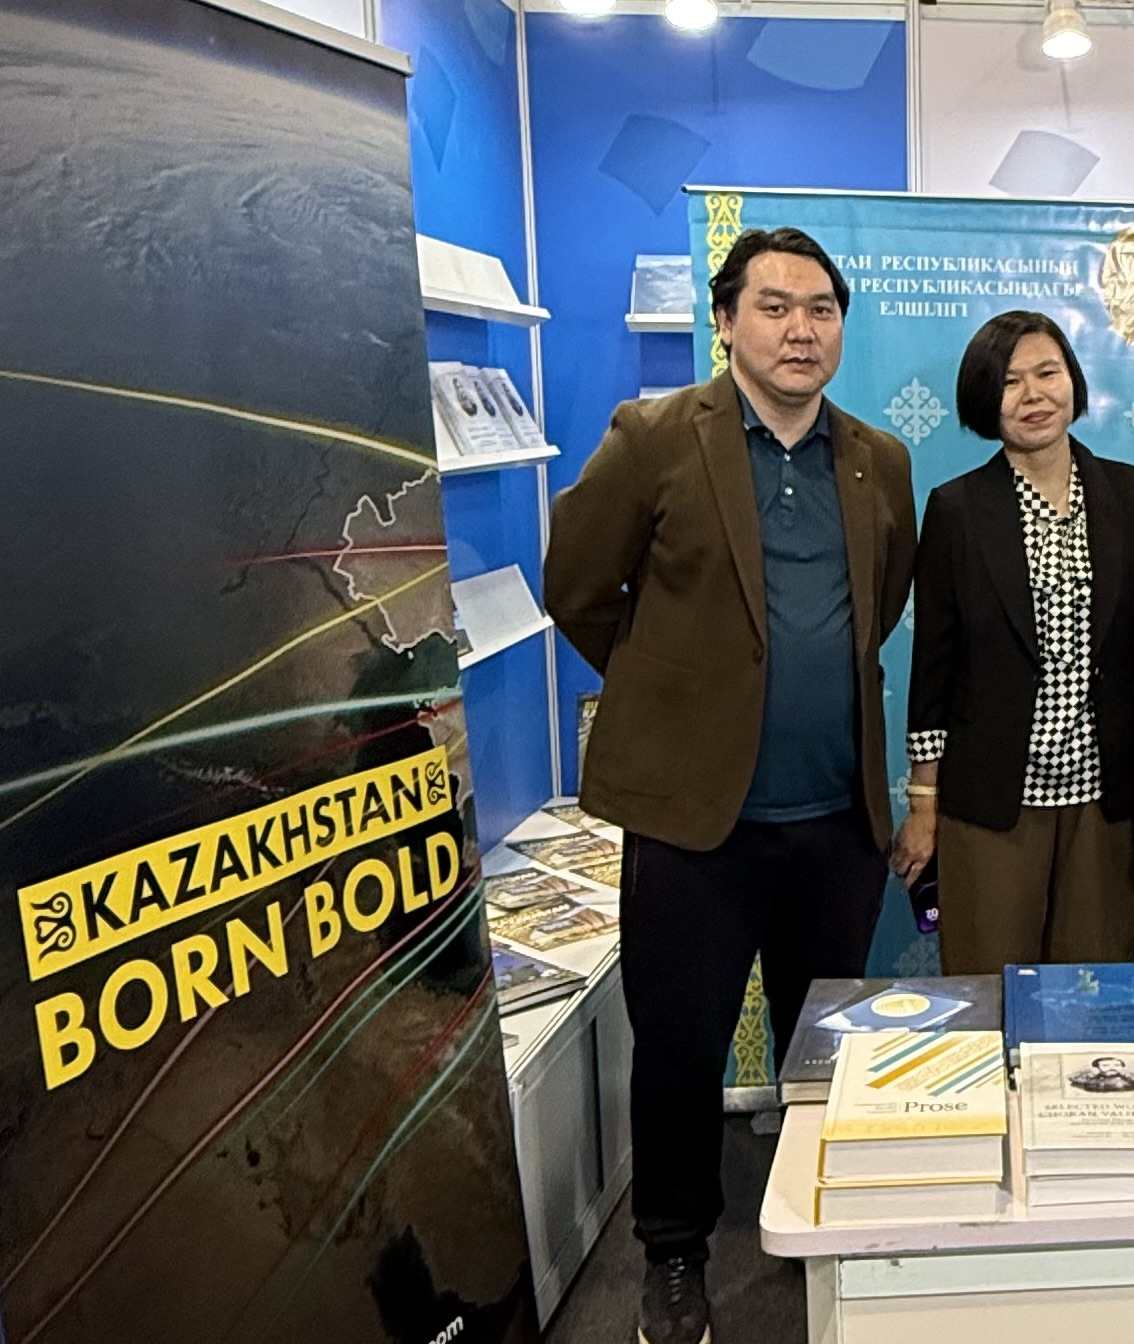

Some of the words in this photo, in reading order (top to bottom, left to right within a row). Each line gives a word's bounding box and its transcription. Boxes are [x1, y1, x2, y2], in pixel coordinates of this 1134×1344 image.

[81, 766, 424, 943] KAZAKHSTAN
[35, 900, 289, 1091] BORN
[303, 830, 460, 959] BOLD
[904, 1101, 969, 1114] Prose
